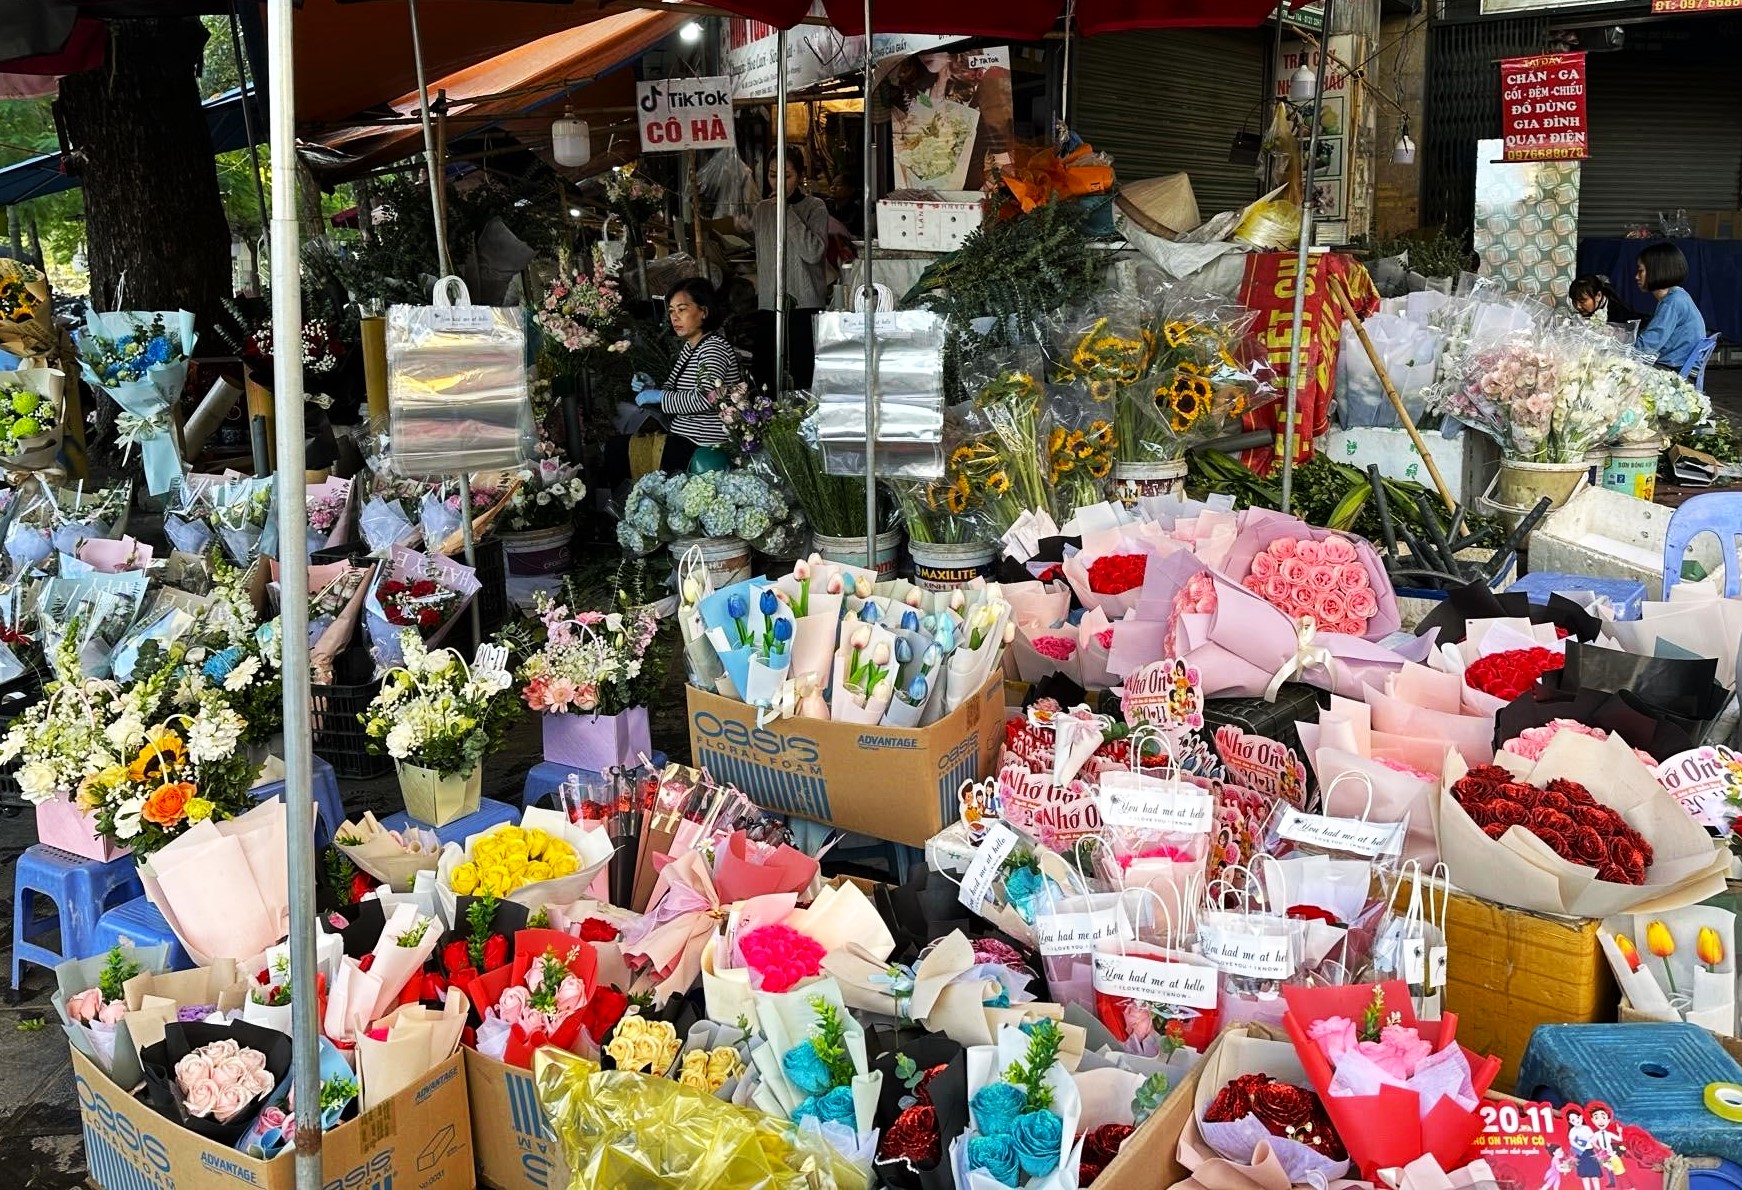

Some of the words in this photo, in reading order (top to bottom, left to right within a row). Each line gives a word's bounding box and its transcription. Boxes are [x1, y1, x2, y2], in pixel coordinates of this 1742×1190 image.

[979, 56, 1000, 65] TikTok
[1558, 69, 1579, 80] GA
[668, 90, 729, 108] TikTok
[1504, 86, 1522, 100] GỐI
[1529, 85, 1549, 100] ĐỆM
[1511, 100, 1532, 115] ĐỒ
[1535, 100, 1577, 113] DÙNG
[646, 116, 682, 144] CÔ
[691, 114, 728, 141] HÀ
[1513, 119, 1540, 129] GIA
[1543, 115, 1580, 128] ĐÌNH
[922, 568, 977, 580] MAXILITE
[924, 581, 946, 590] KINH
[858, 734, 918, 748] ADVANTAGE
[696, 735, 761, 761] FLORAL
[769, 757, 821, 775] FOAM
[1043, 804, 1081, 830] Nhớ
[1120, 801, 1138, 814] You
[1143, 802, 1159, 815] had
[1162, 808, 1174, 816] me
[1177, 808, 1186, 818] at
[1301, 823, 1319, 834] You
[1322, 827, 1340, 838] had
[1357, 835, 1369, 843] at
[969, 877, 981, 897] had
[986, 853, 993, 865] at
[1058, 928, 1074, 942] had
[1078, 932, 1090, 940] me
[1092, 929, 1101, 940] at
[1221, 943, 1239, 958] had
[1242, 952, 1256, 960] me
[1259, 951, 1270, 962] at
[1103, 966, 1124, 982] You
[1128, 970, 1148, 983] had
[1150, 978, 1165, 987] me
[1169, 979, 1179, 988] at
[1184, 978, 1205, 992] hello
[415, 1065, 459, 1103] ADVANTAGE
[1532, 1134, 1545, 1146] CÔ
[201, 1151, 257, 1184] ADVANTAGE
